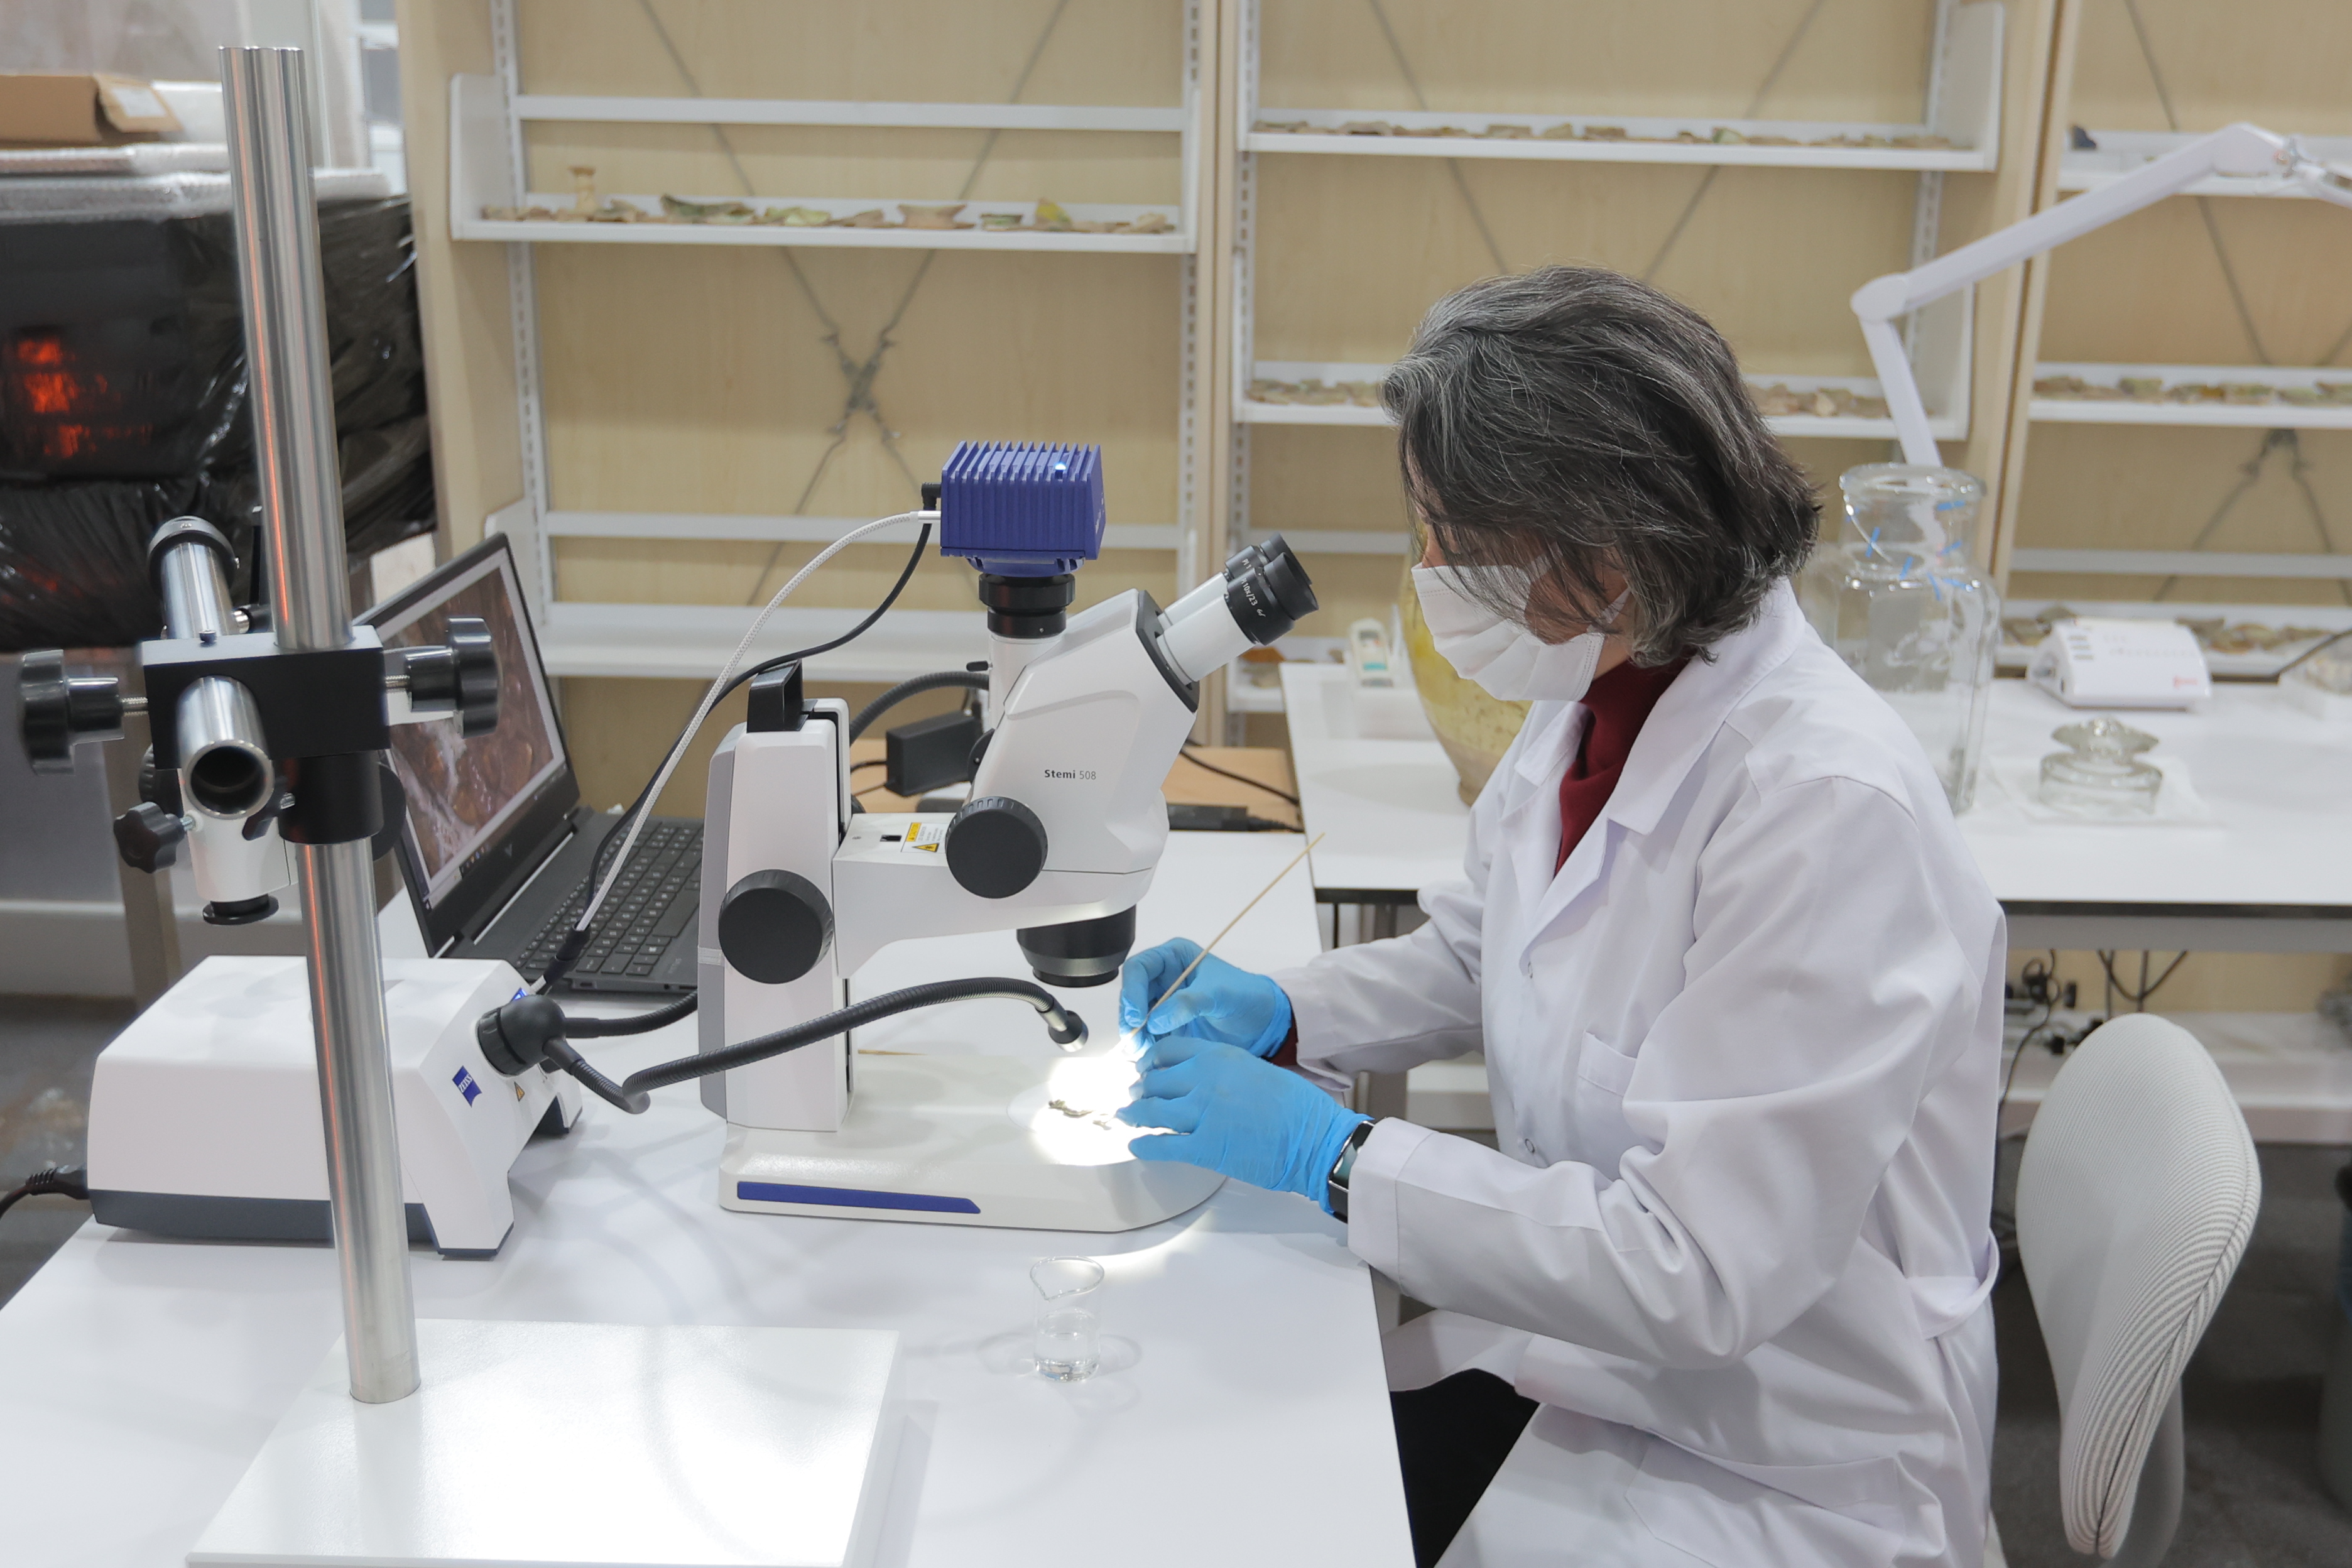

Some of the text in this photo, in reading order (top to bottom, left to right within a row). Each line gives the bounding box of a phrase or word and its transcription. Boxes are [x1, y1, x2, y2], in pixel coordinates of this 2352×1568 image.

[1243, 583, 1258, 606] 10x/23
[1045, 769, 1096, 780] Stemi 508
[458, 1073, 472, 1093] ZEISS
